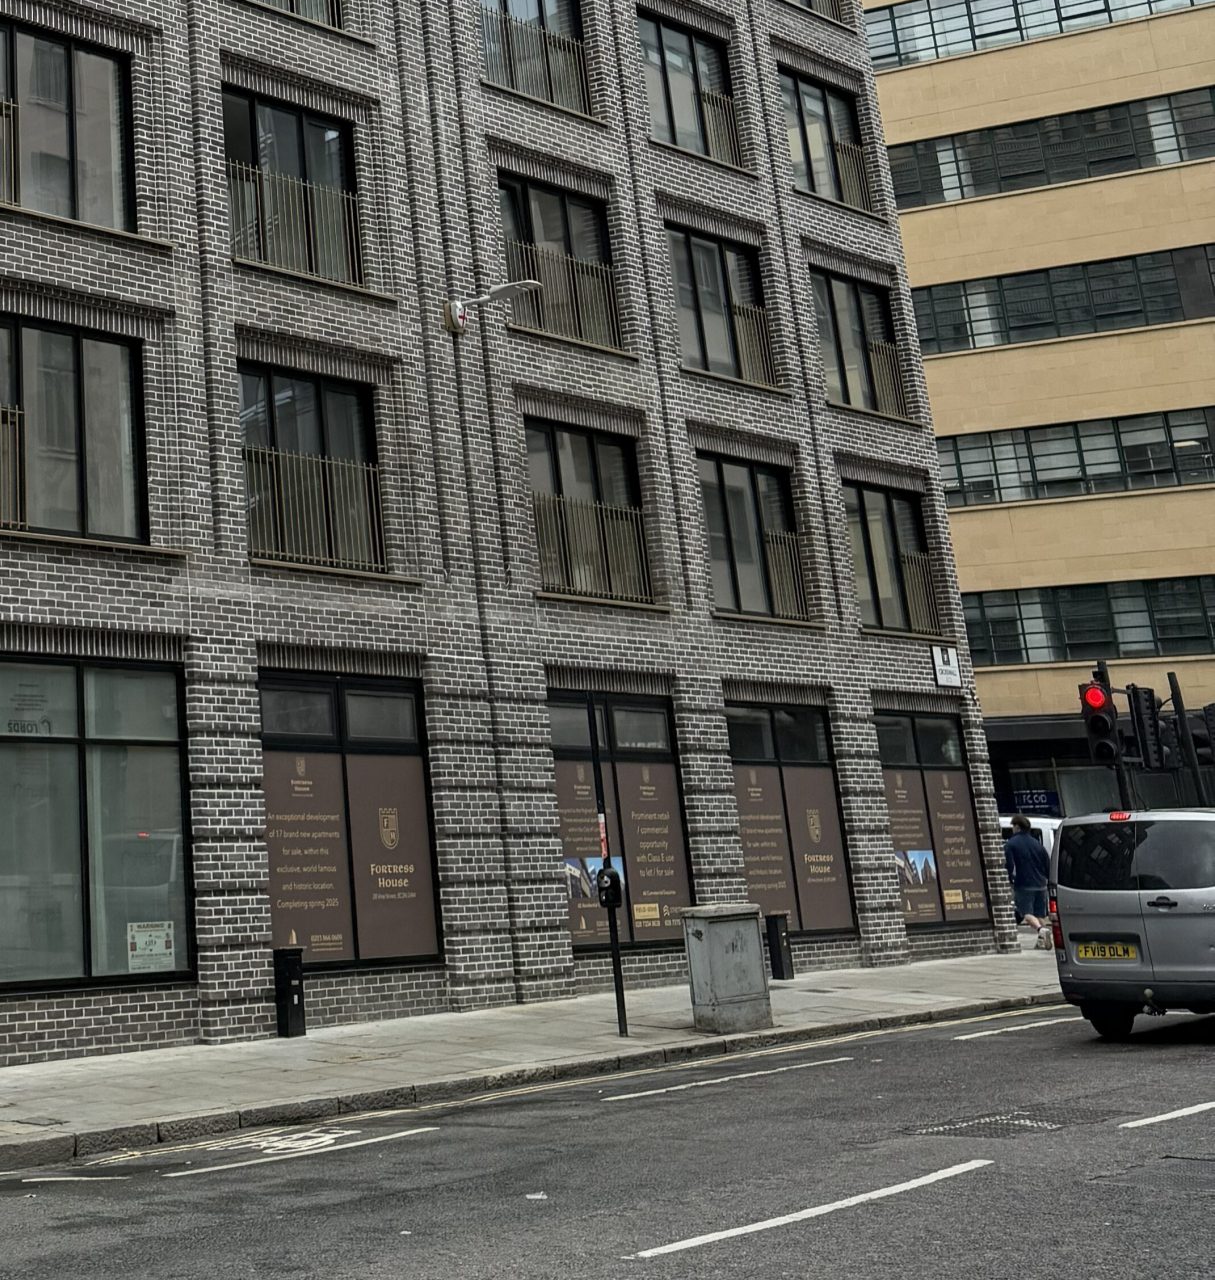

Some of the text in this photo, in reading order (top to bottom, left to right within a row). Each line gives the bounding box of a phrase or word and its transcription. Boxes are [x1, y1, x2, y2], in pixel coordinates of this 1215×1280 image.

[7, 721, 39, 734] LORDS
[305, 811, 340, 822] development
[1084, 946, 1106, 957] FV19
